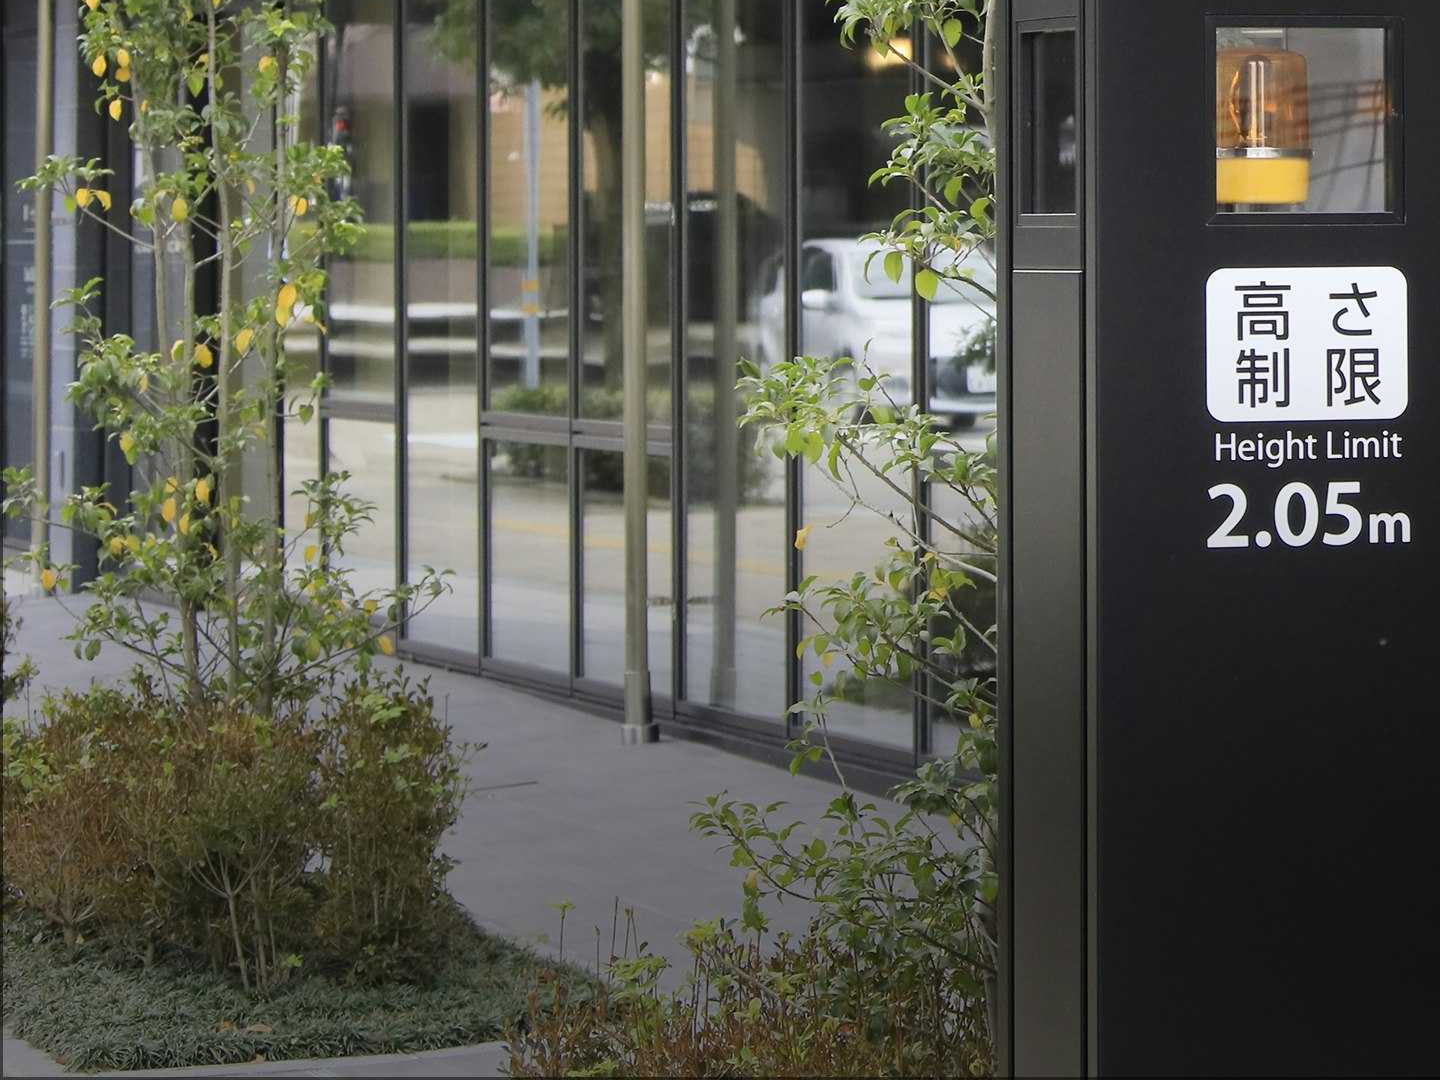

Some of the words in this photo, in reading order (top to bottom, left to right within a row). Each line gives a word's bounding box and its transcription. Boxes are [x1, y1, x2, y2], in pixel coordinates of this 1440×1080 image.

[1234, 280, 1378, 341] 高さ
[1236, 348, 1381, 408] 制限
[1215, 430, 1318, 468] Height
[1326, 430, 1403, 459] Limit
[1206, 481, 1411, 548] 2.05m
